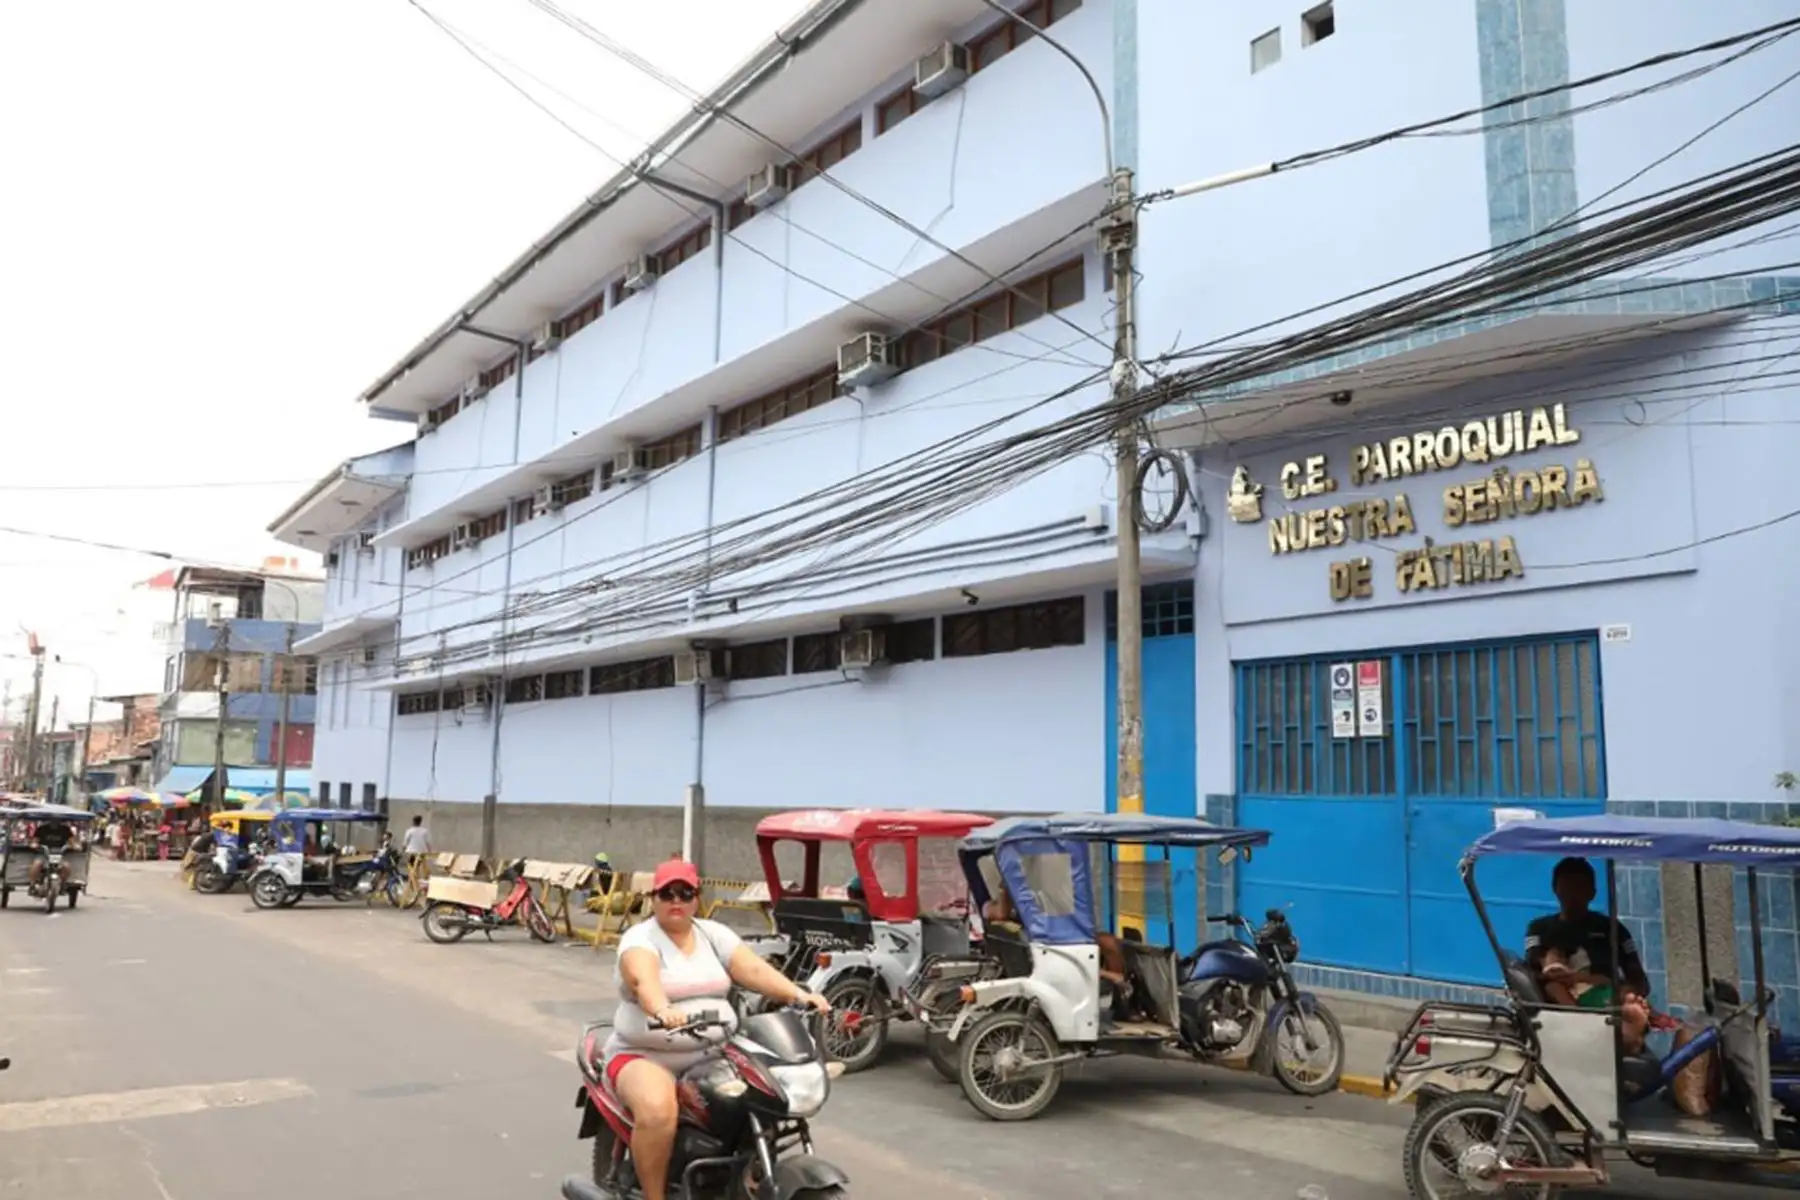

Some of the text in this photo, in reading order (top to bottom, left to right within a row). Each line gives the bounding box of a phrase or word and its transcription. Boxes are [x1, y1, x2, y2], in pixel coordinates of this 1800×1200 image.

[1280, 402, 1581, 500] C.E. PARROQUIAL
[1269, 457, 1604, 555] NUESTRA SEÑORA
[1330, 535, 1525, 602] DE FÁTIMA
